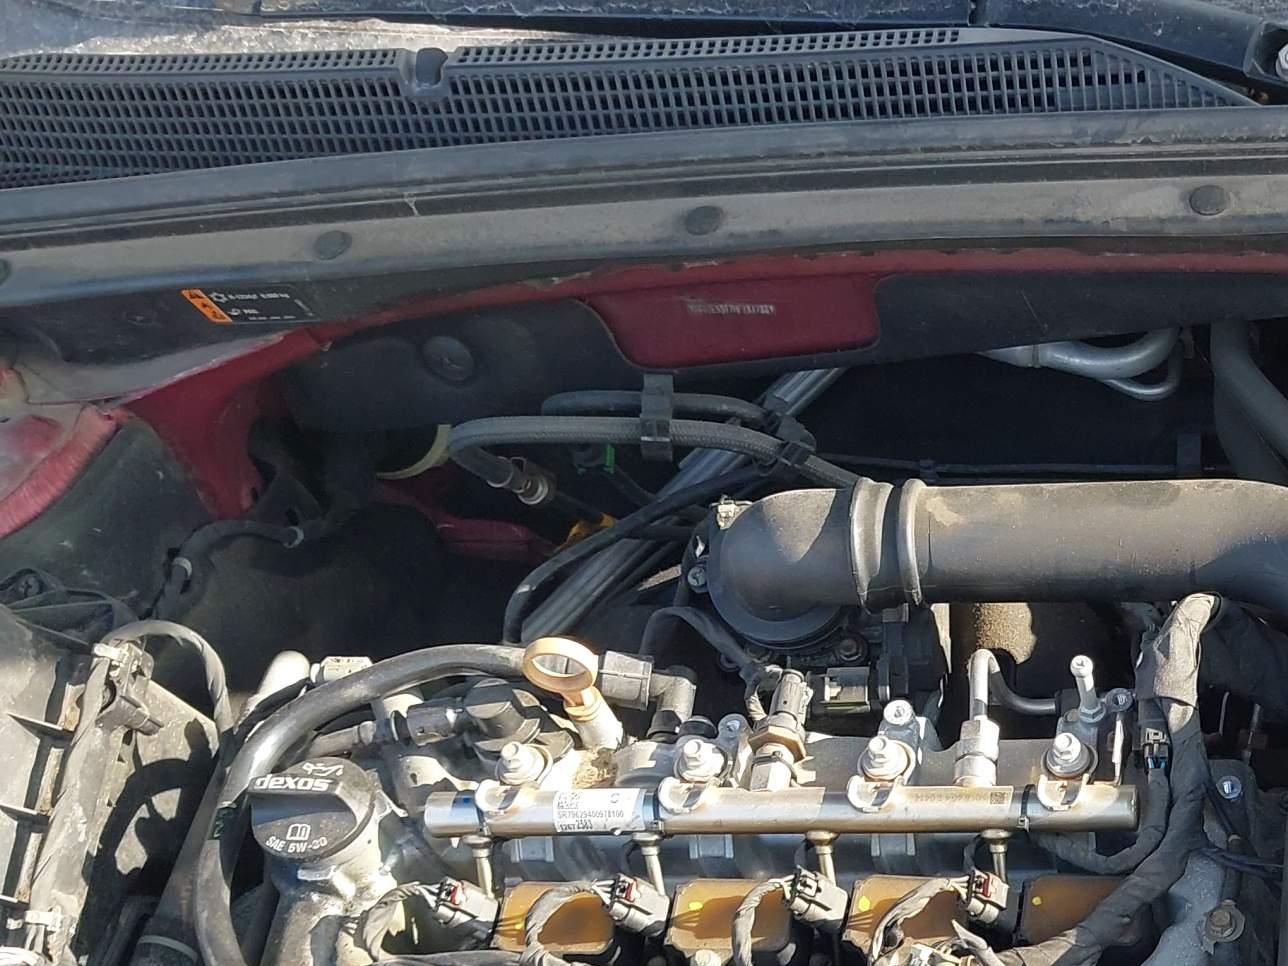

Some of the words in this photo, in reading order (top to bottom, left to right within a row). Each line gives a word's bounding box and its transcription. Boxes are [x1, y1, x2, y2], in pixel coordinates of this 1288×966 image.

[254, 774, 334, 791] dexos
[266, 836, 286, 852] SAE
[288, 837, 328, 853] 5W-30
